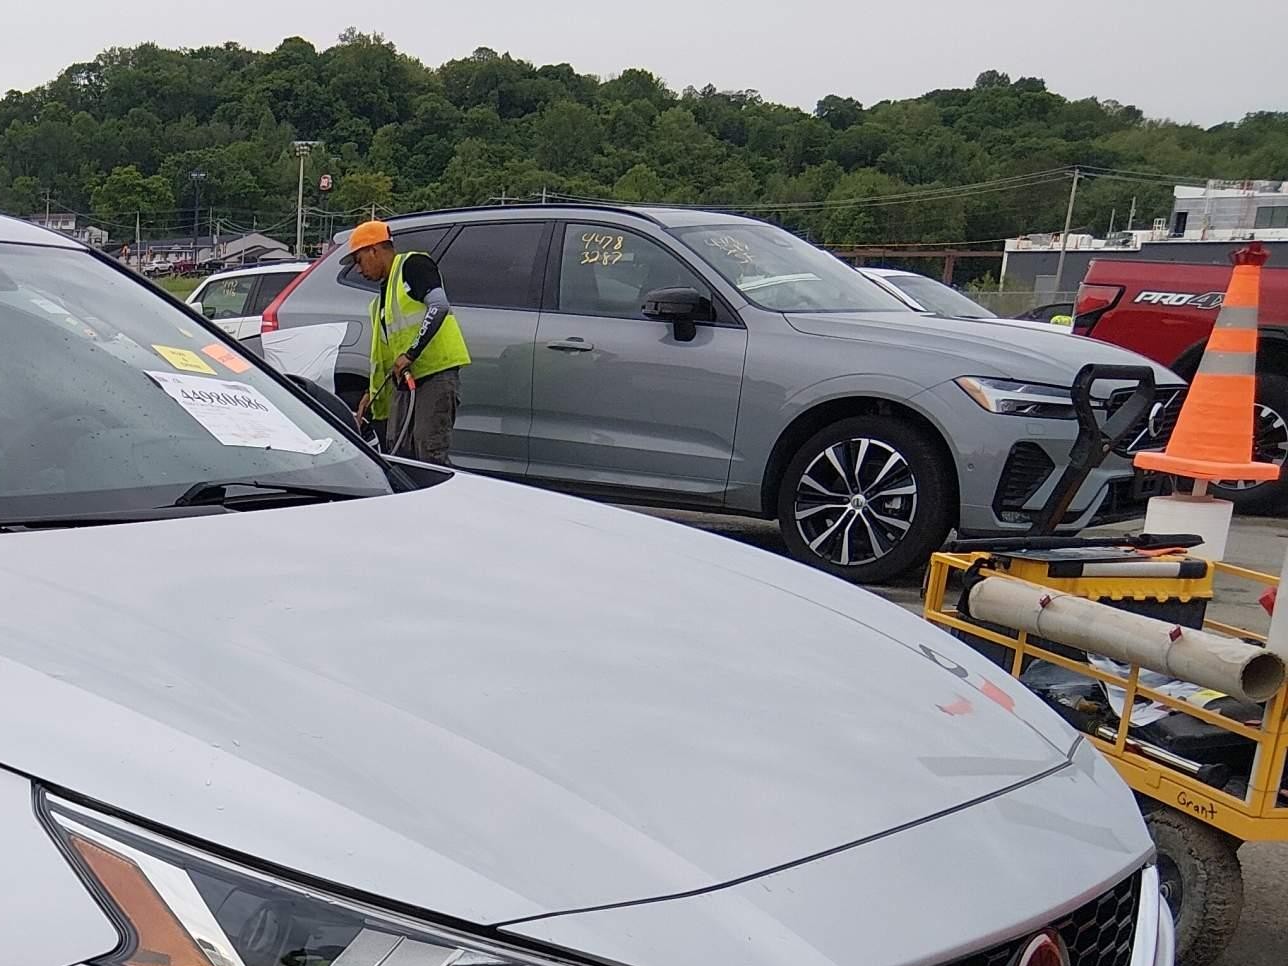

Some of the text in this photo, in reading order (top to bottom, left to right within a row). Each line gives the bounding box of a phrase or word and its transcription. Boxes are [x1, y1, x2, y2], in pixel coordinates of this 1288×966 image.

[582, 232, 623, 250] 4478
[581, 250, 623, 265] 3287
[181, 389, 269, 413] 44980686
[1177, 791, 1218, 820] Grant
